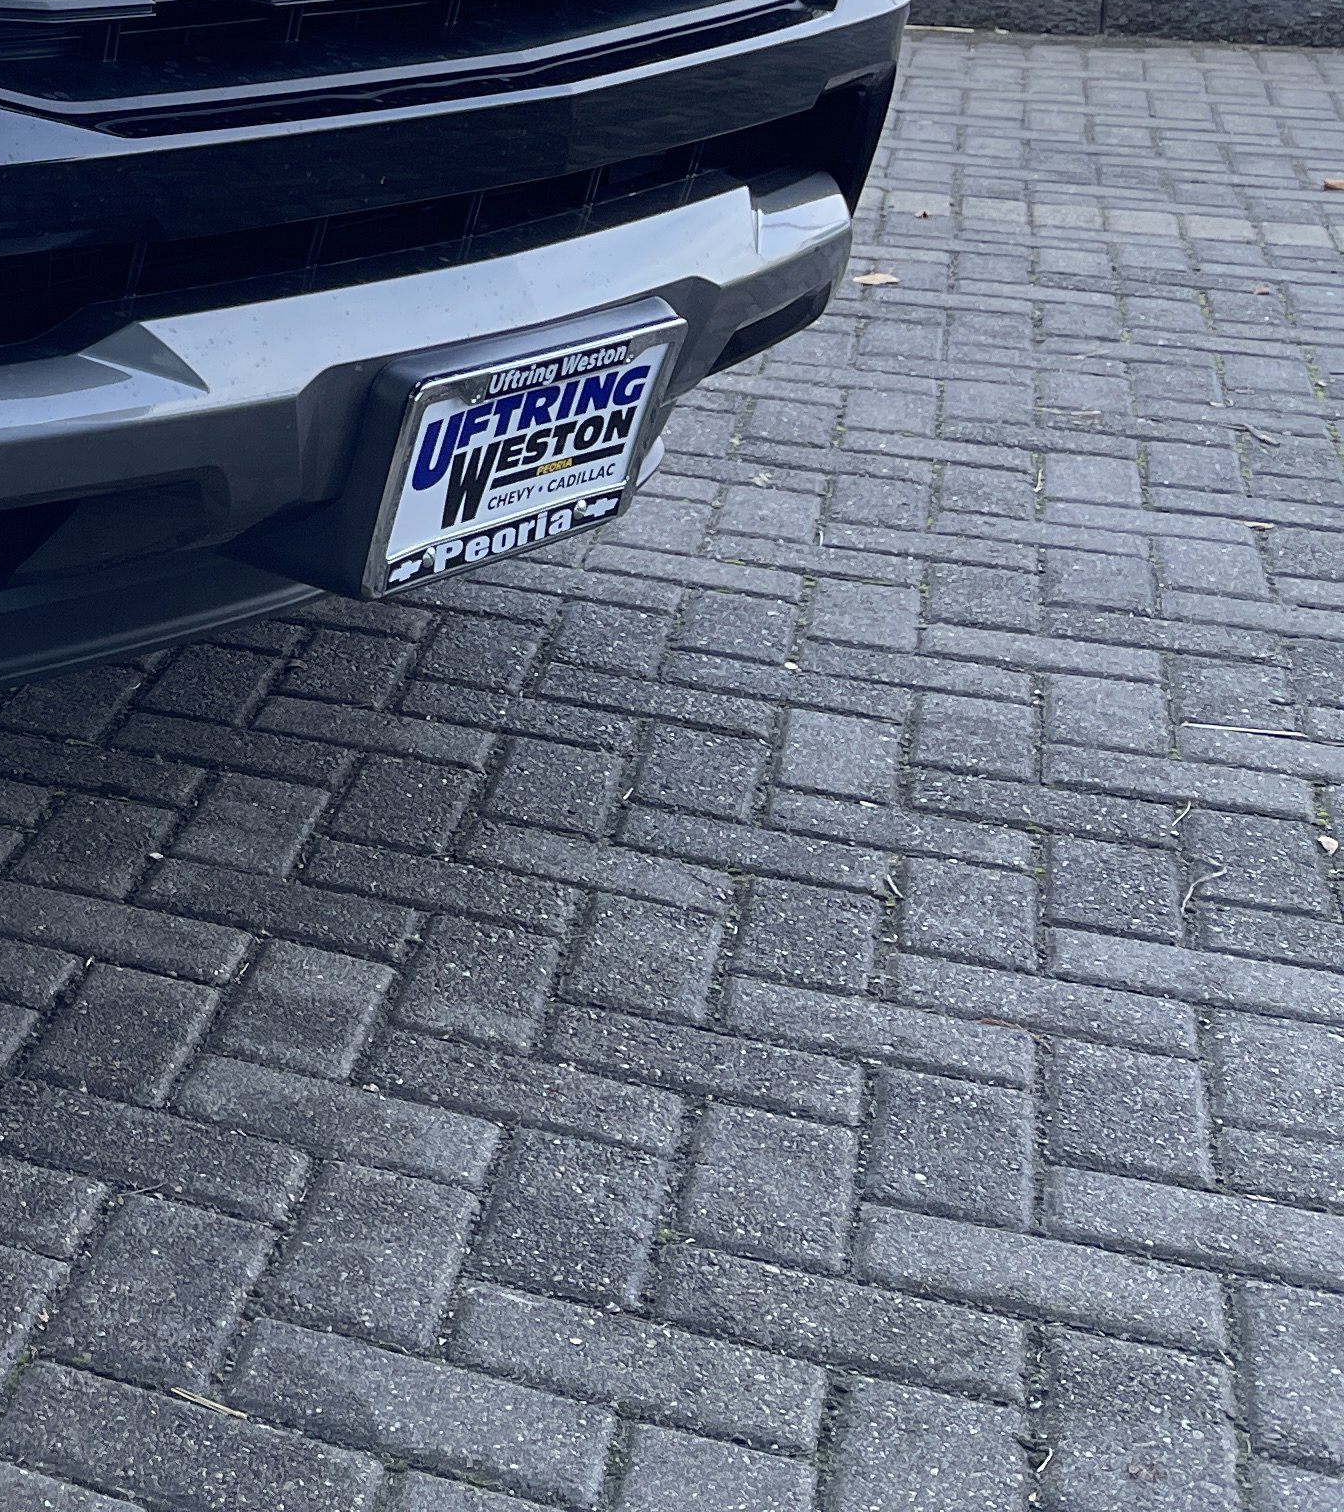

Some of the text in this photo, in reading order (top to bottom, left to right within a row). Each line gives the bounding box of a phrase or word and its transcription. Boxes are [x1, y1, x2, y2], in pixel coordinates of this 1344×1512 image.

[490, 345, 628, 395] Uftring Weston
[412, 365, 651, 491] UFTRING
[441, 405, 638, 530] WESTON
[487, 462, 616, 511] CHEVY CADILLAC
[535, 457, 573, 476] PEORIA
[433, 508, 572, 573] Peoria
